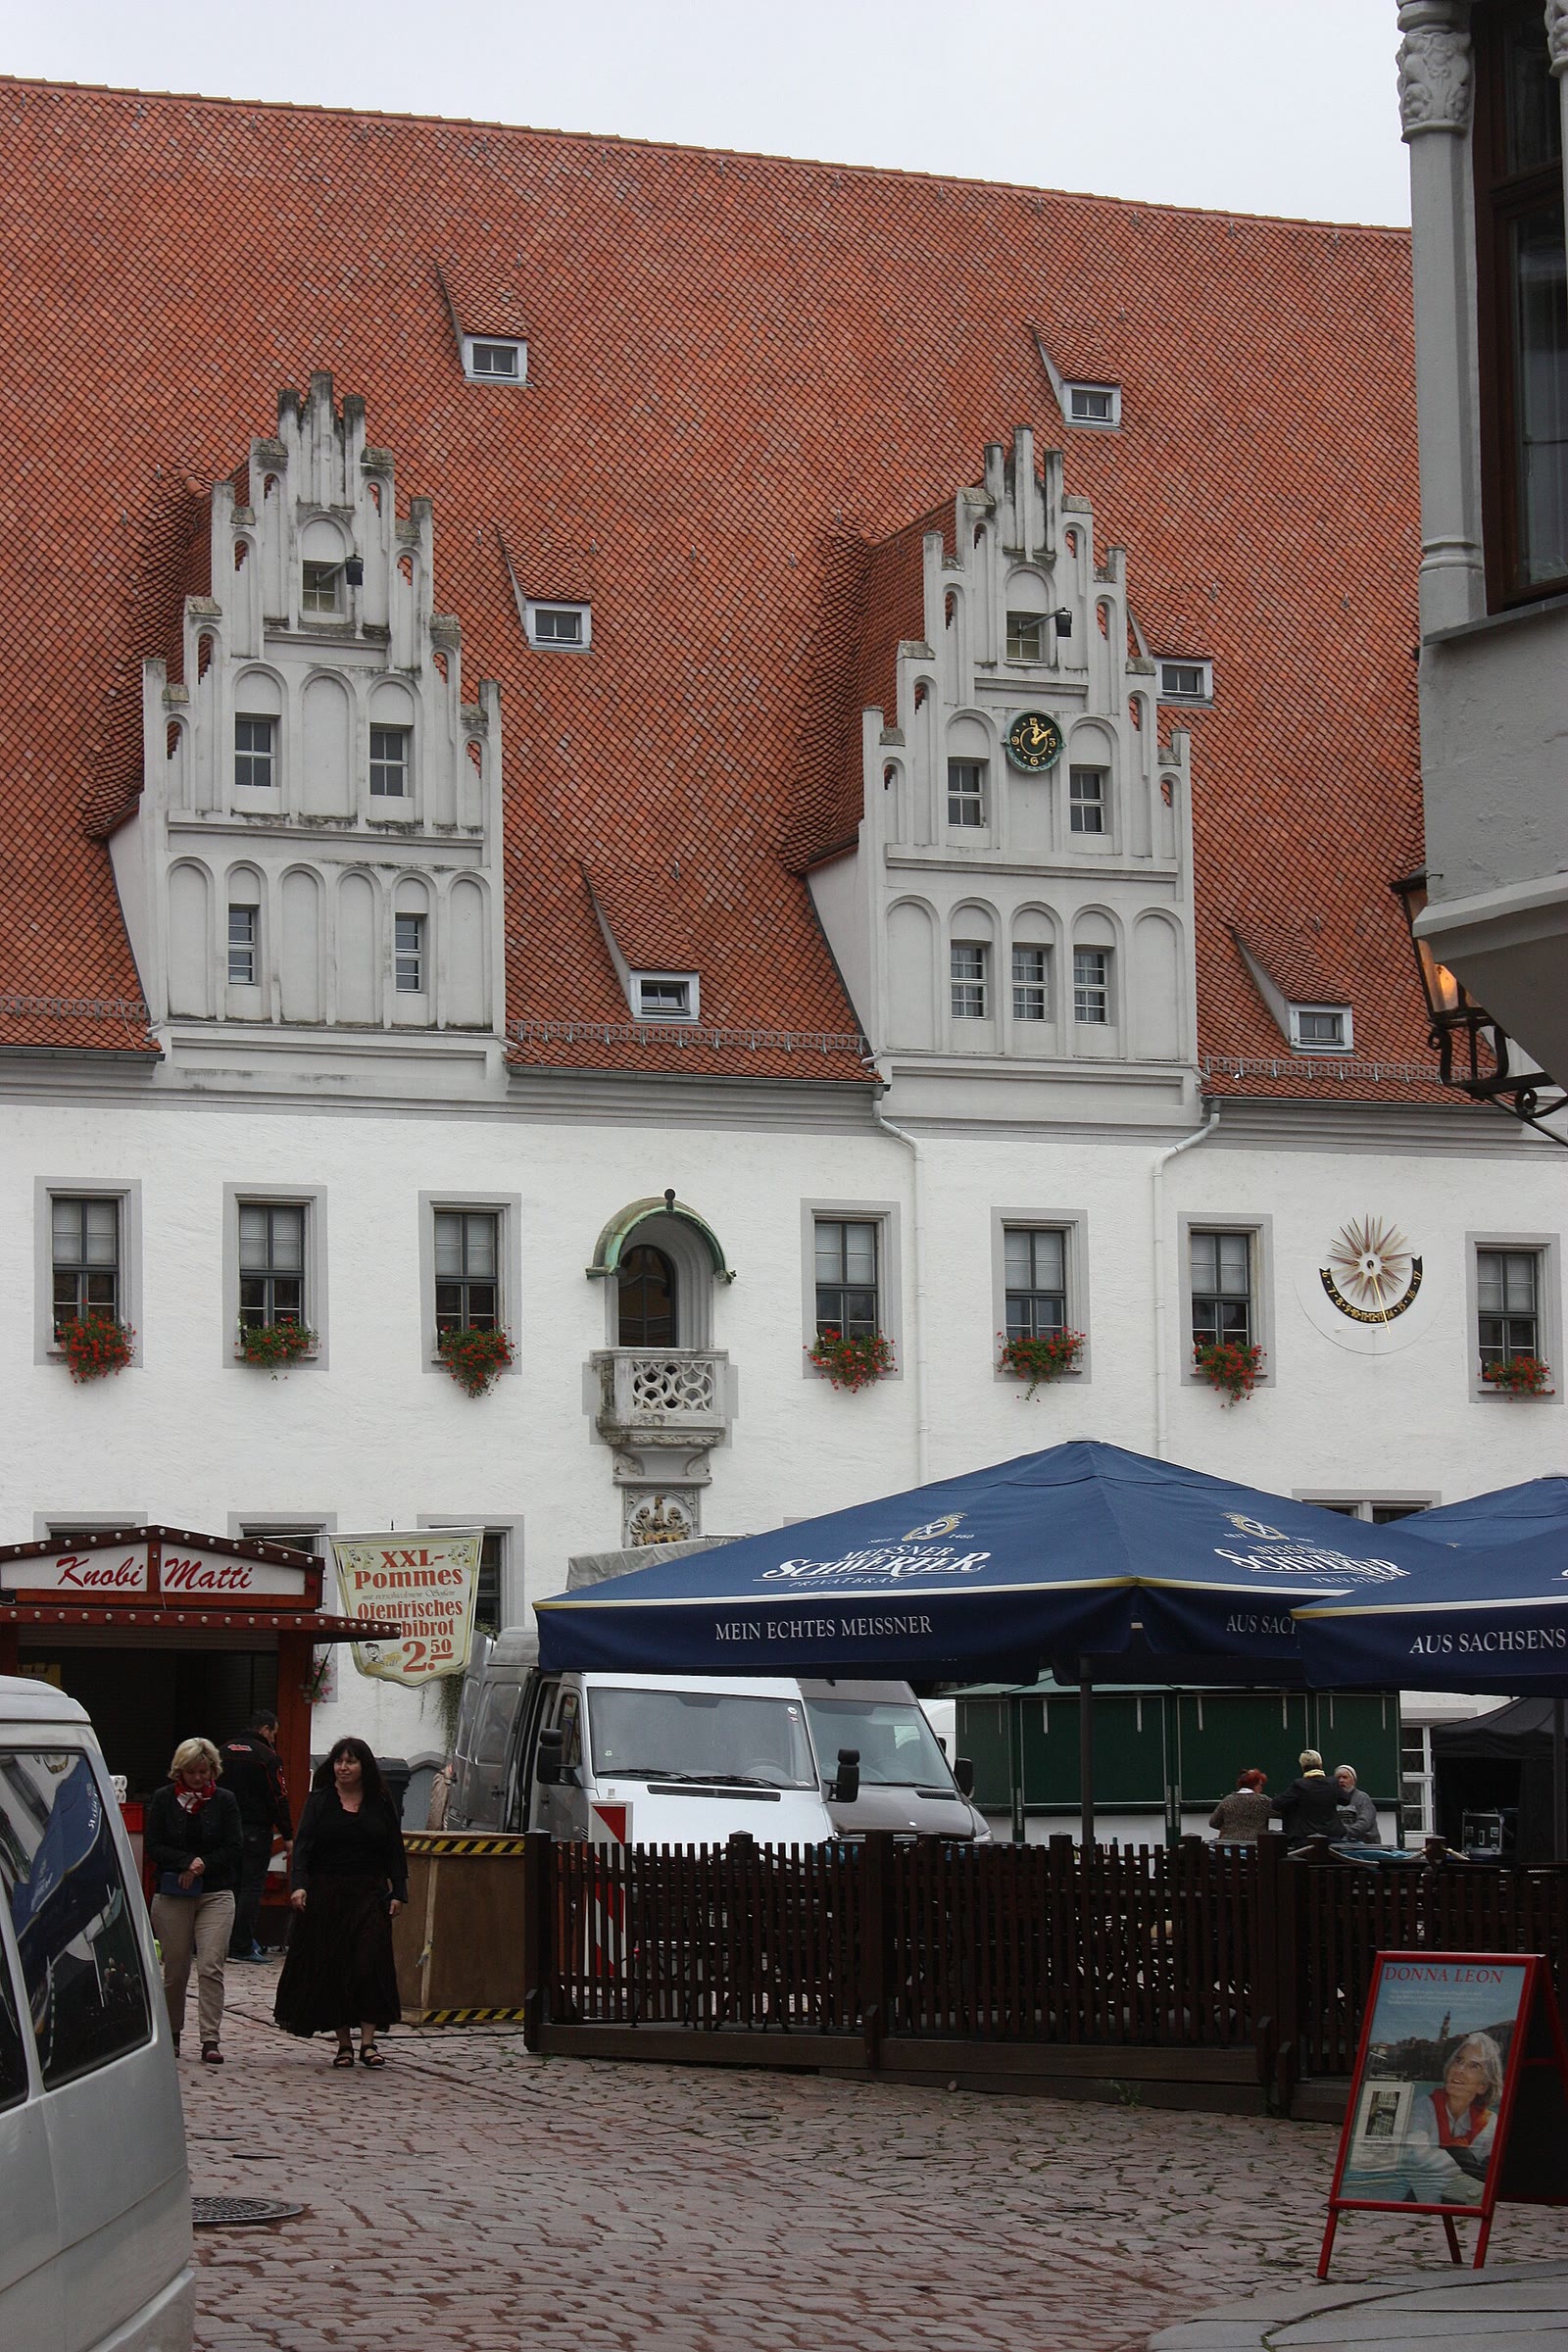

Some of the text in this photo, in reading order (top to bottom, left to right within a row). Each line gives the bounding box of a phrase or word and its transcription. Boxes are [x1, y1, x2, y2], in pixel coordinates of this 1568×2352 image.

[1011, 736, 1019, 745] 9
[1030, 757, 1039, 765] 6
[380, 1548, 445, 1568] XXL-
[56, 1555, 253, 1590] Knobi Matti
[354, 1568, 464, 1590] Pommes
[358, 1598, 464, 1620] Ofenfrisches
[715, 1615, 933, 1641] MEIN ECHTES MEISSNER
[1226, 1614, 1257, 1633] AUS
[1409, 1628, 1566, 1654] AUS SACHSENS
[1385, 1966, 1505, 1984] DONNA LEON
